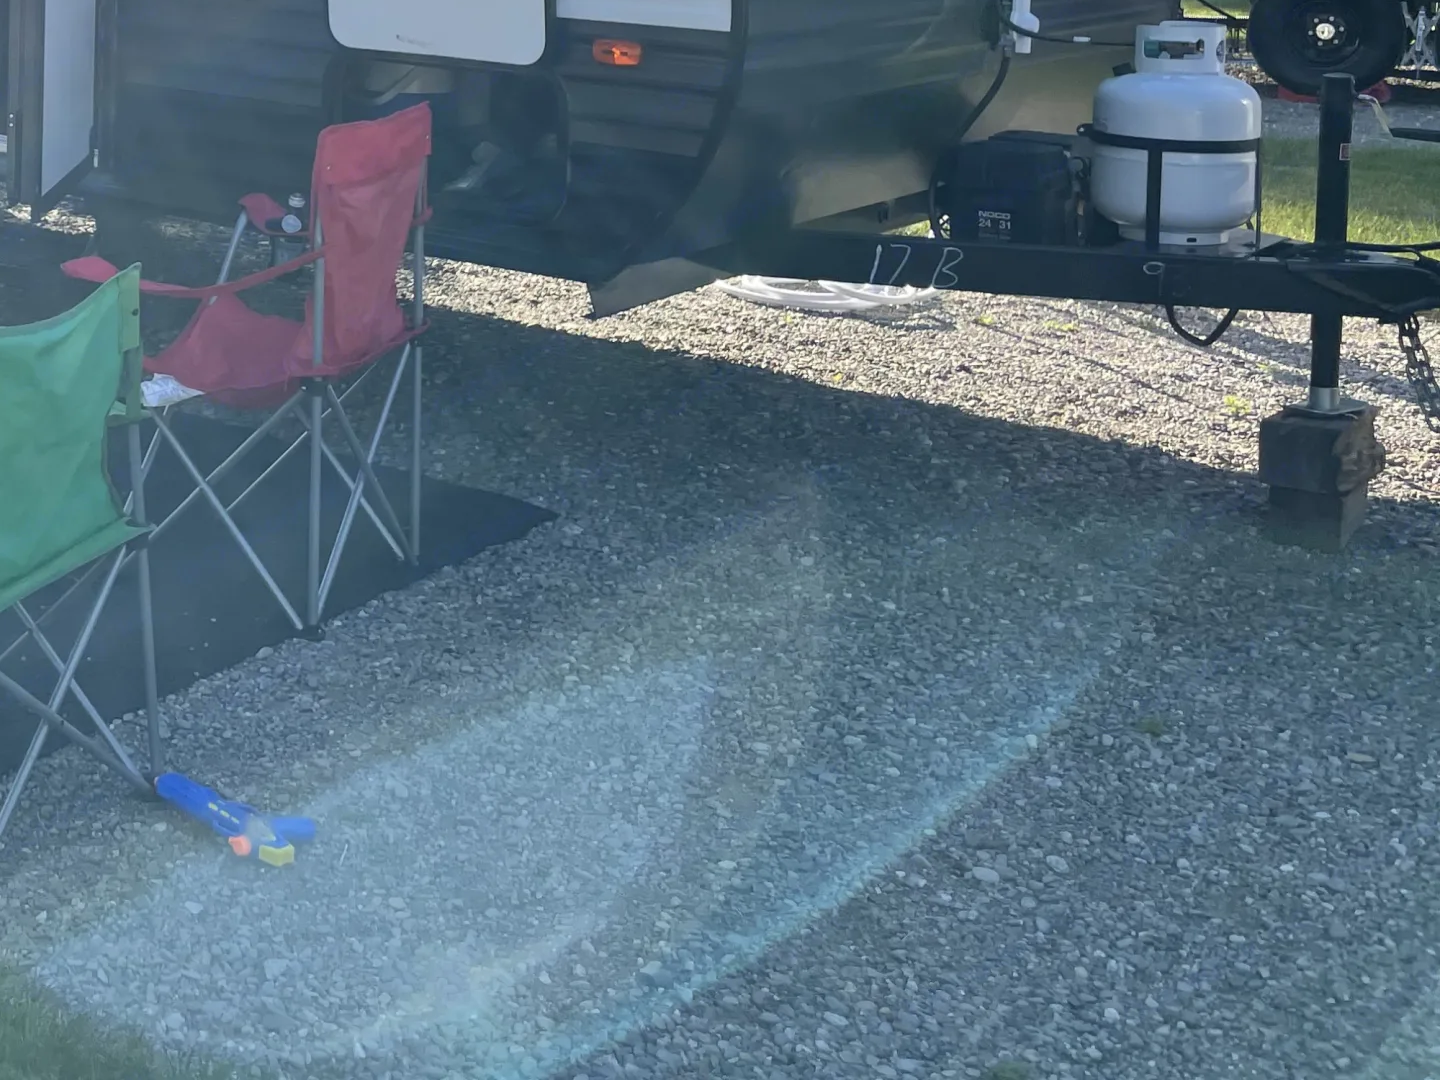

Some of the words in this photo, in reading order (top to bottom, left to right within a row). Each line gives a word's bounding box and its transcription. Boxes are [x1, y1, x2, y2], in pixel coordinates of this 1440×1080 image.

[978, 210, 1011, 220] NOCO
[999, 220, 1011, 230] 31
[869, 244, 911, 285] 17
[932, 246, 964, 288] B
